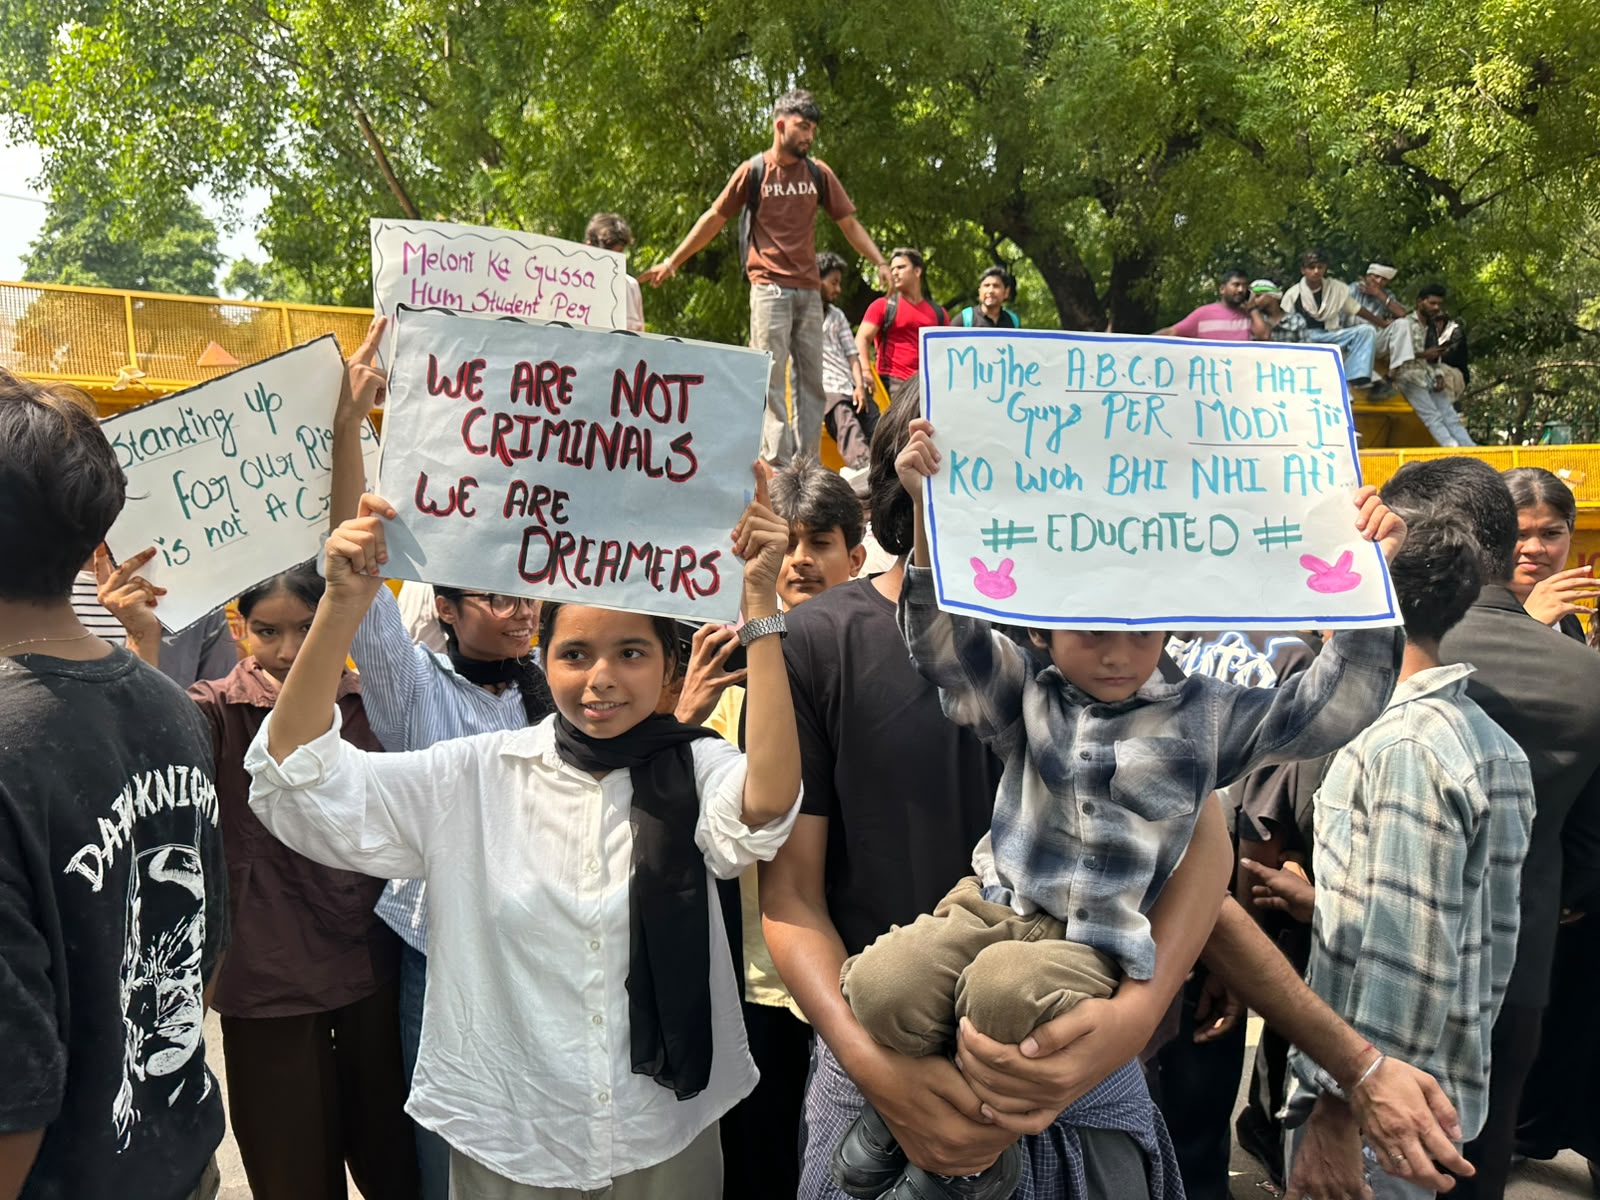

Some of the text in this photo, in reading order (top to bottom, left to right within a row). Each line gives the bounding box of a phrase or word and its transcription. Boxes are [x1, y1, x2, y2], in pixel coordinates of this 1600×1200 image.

[764, 181, 818, 198] PRADA
[403, 240, 597, 300] Meloni Ka Gussa
[410, 278, 463, 311] Hum
[471, 288, 541, 316] Student
[427, 353, 704, 424] WE ARE NOT
[947, 344, 1042, 404] Mujhe
[1256, 361, 1322, 396] HAI
[112, 381, 283, 470] Standing up
[461, 407, 699, 483] CRIMINALS
[1102, 391, 1172, 441] PER
[414, 471, 479, 518] WE
[502, 479, 570, 528] ARE
[1107, 453, 1168, 497] BHI
[1192, 454, 1268, 500] NHI
[153, 535, 191, 568] is
[204, 513, 248, 548] not
[265, 492, 289, 522] A
[1046, 512, 1240, 557] EDUCATED
[518, 525, 722, 601] DREAMERS
